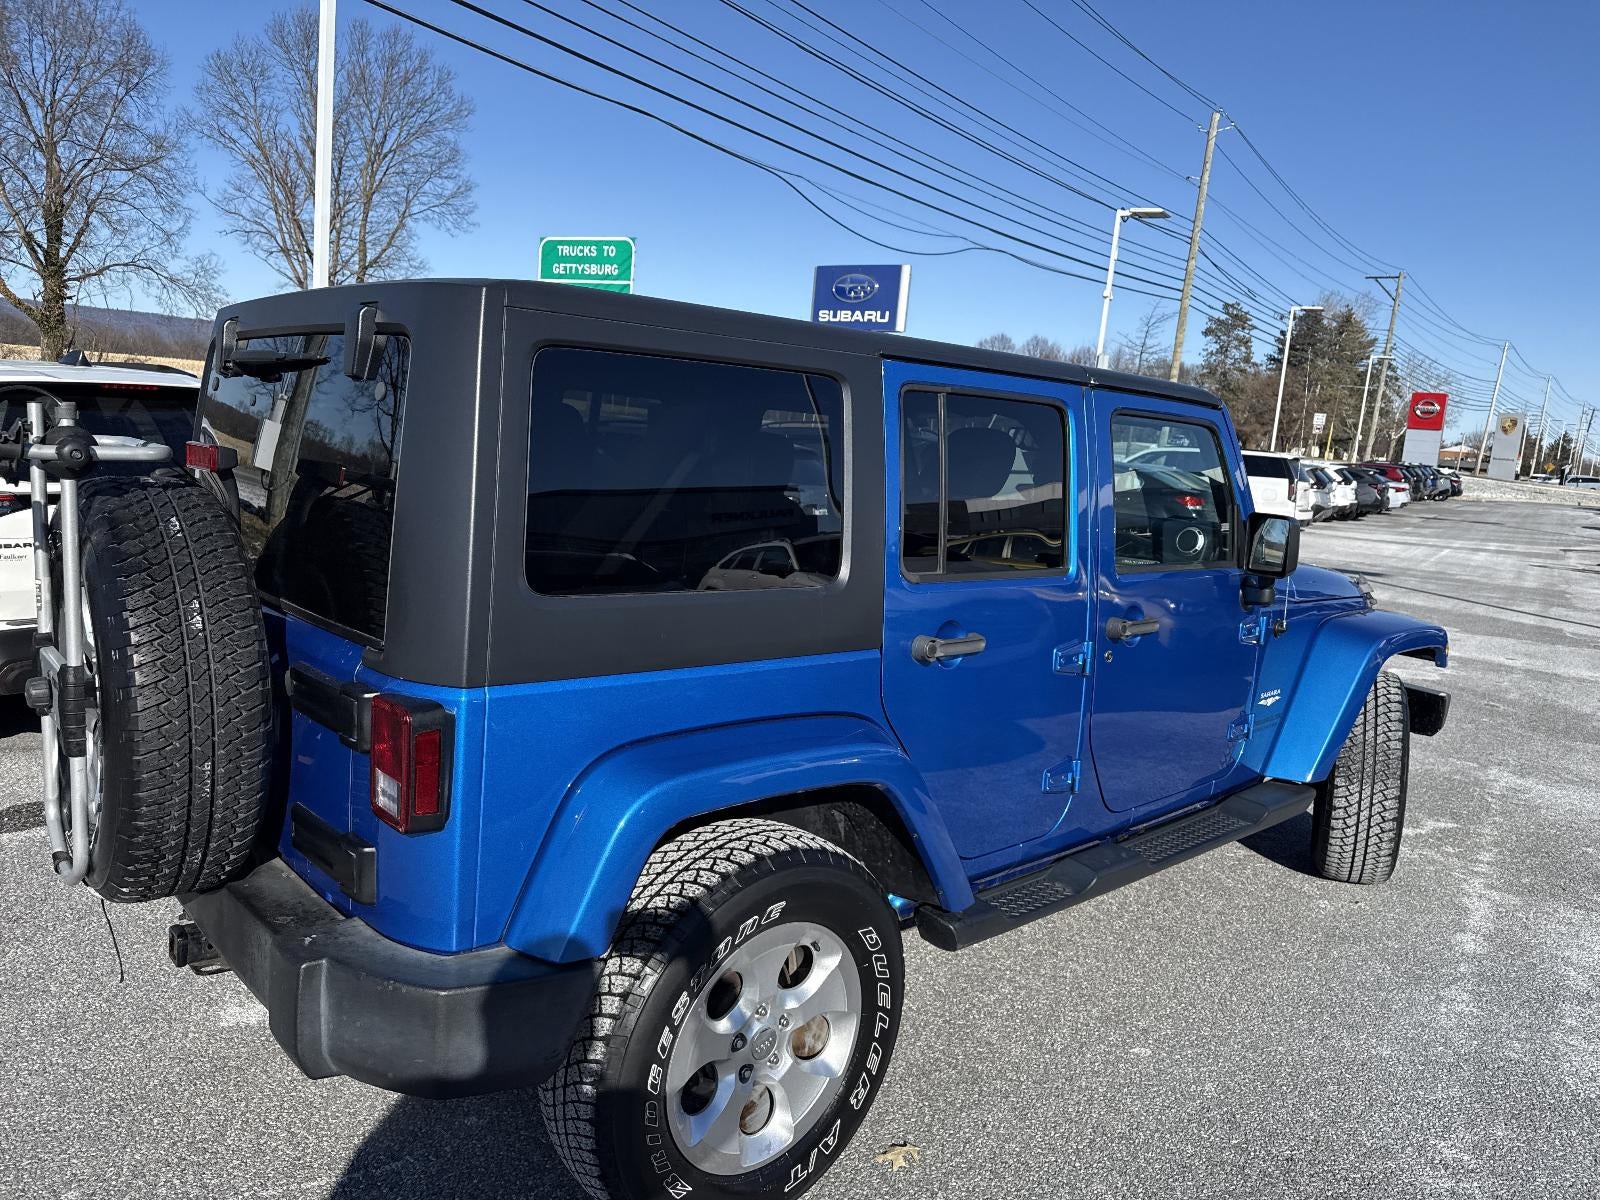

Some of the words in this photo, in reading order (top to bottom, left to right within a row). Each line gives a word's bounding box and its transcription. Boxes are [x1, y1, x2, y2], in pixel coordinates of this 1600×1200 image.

[556, 245, 597, 257] TRUCKS
[603, 245, 616, 257] TO
[552, 262, 618, 276] GETTYSBURG
[818, 308, 890, 323] SUBARU
[1260, 688, 1281, 698] SAHARA
[849, 926, 891, 1110] DUELER
[644, 901, 786, 1199] BRIDGESTONE
[784, 1118, 841, 1193] A/T
